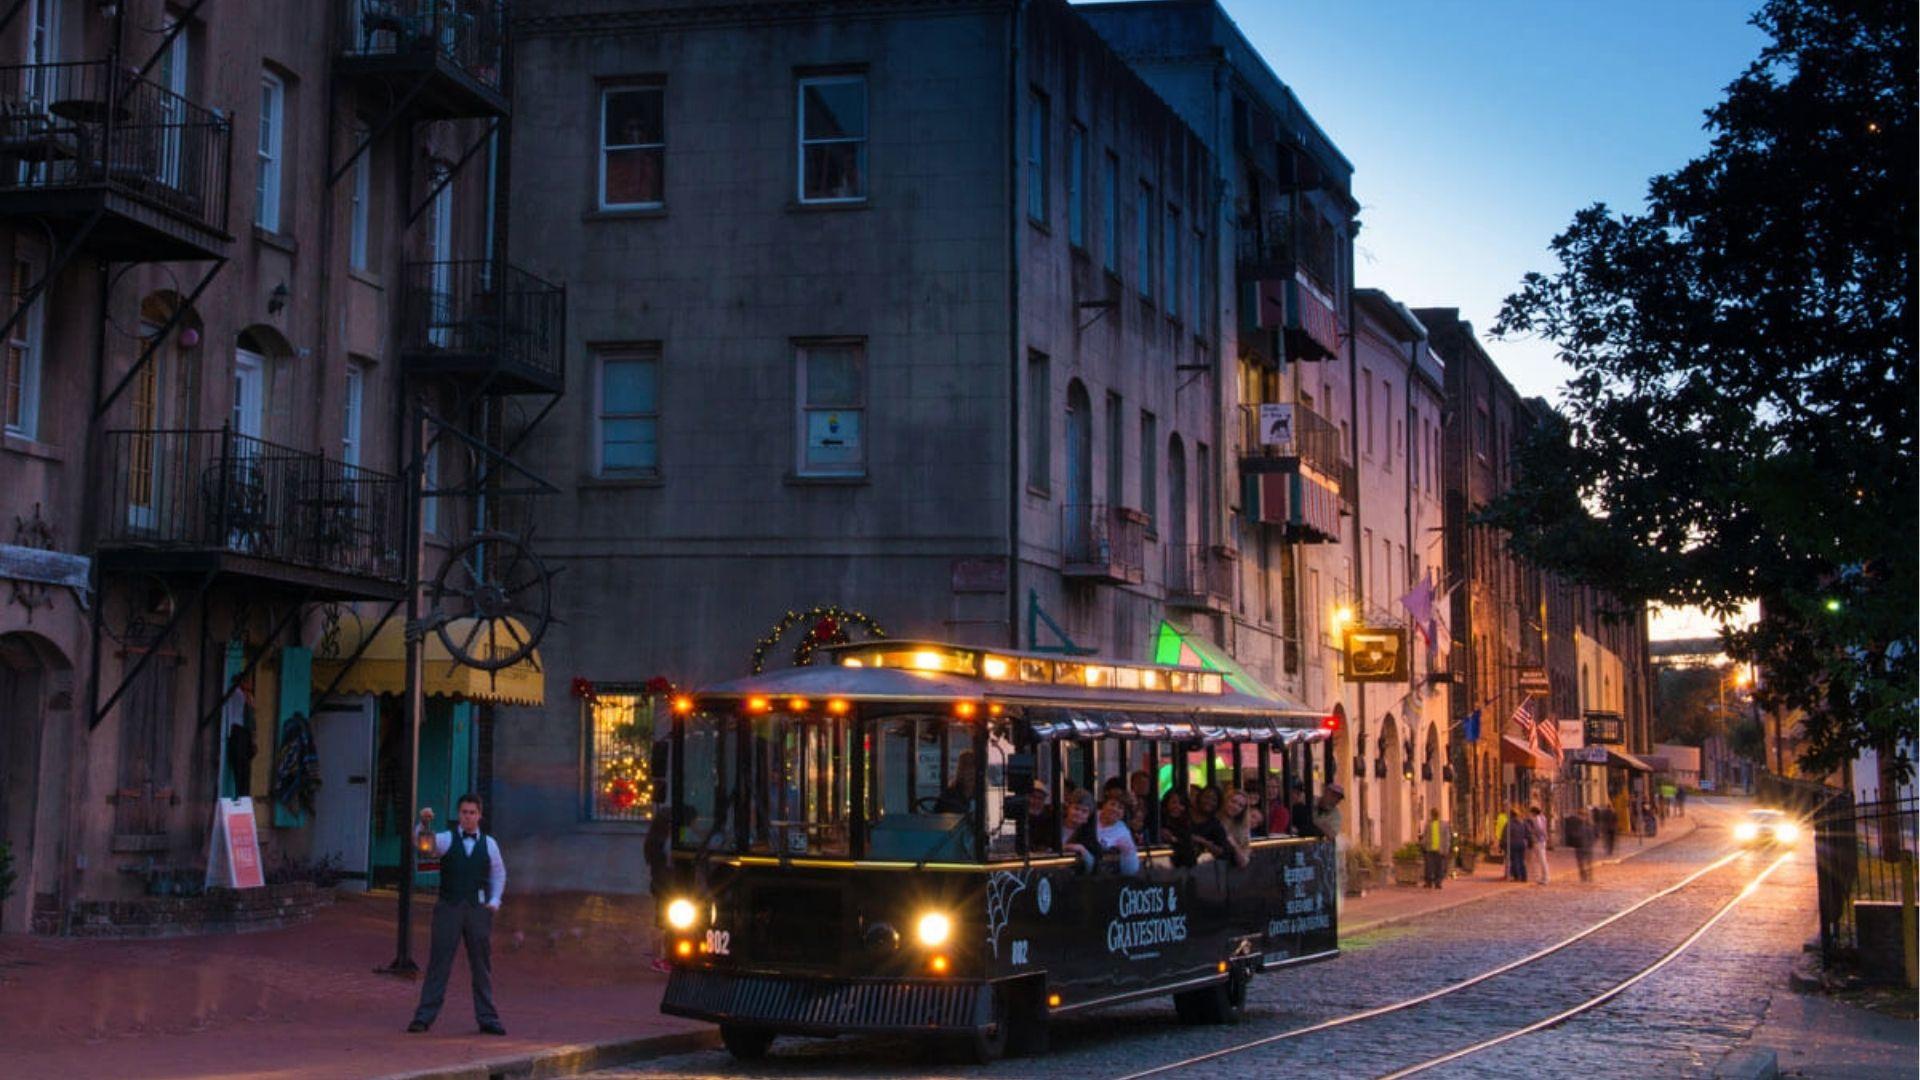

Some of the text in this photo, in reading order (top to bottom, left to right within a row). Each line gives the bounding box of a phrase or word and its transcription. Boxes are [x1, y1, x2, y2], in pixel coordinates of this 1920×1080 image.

[1119, 886, 1177, 918] GHOSTS &
[706, 930, 730, 954] 802
[1107, 915, 1187, 956] GRAVESTONES
[1012, 940, 1028, 965] 802
